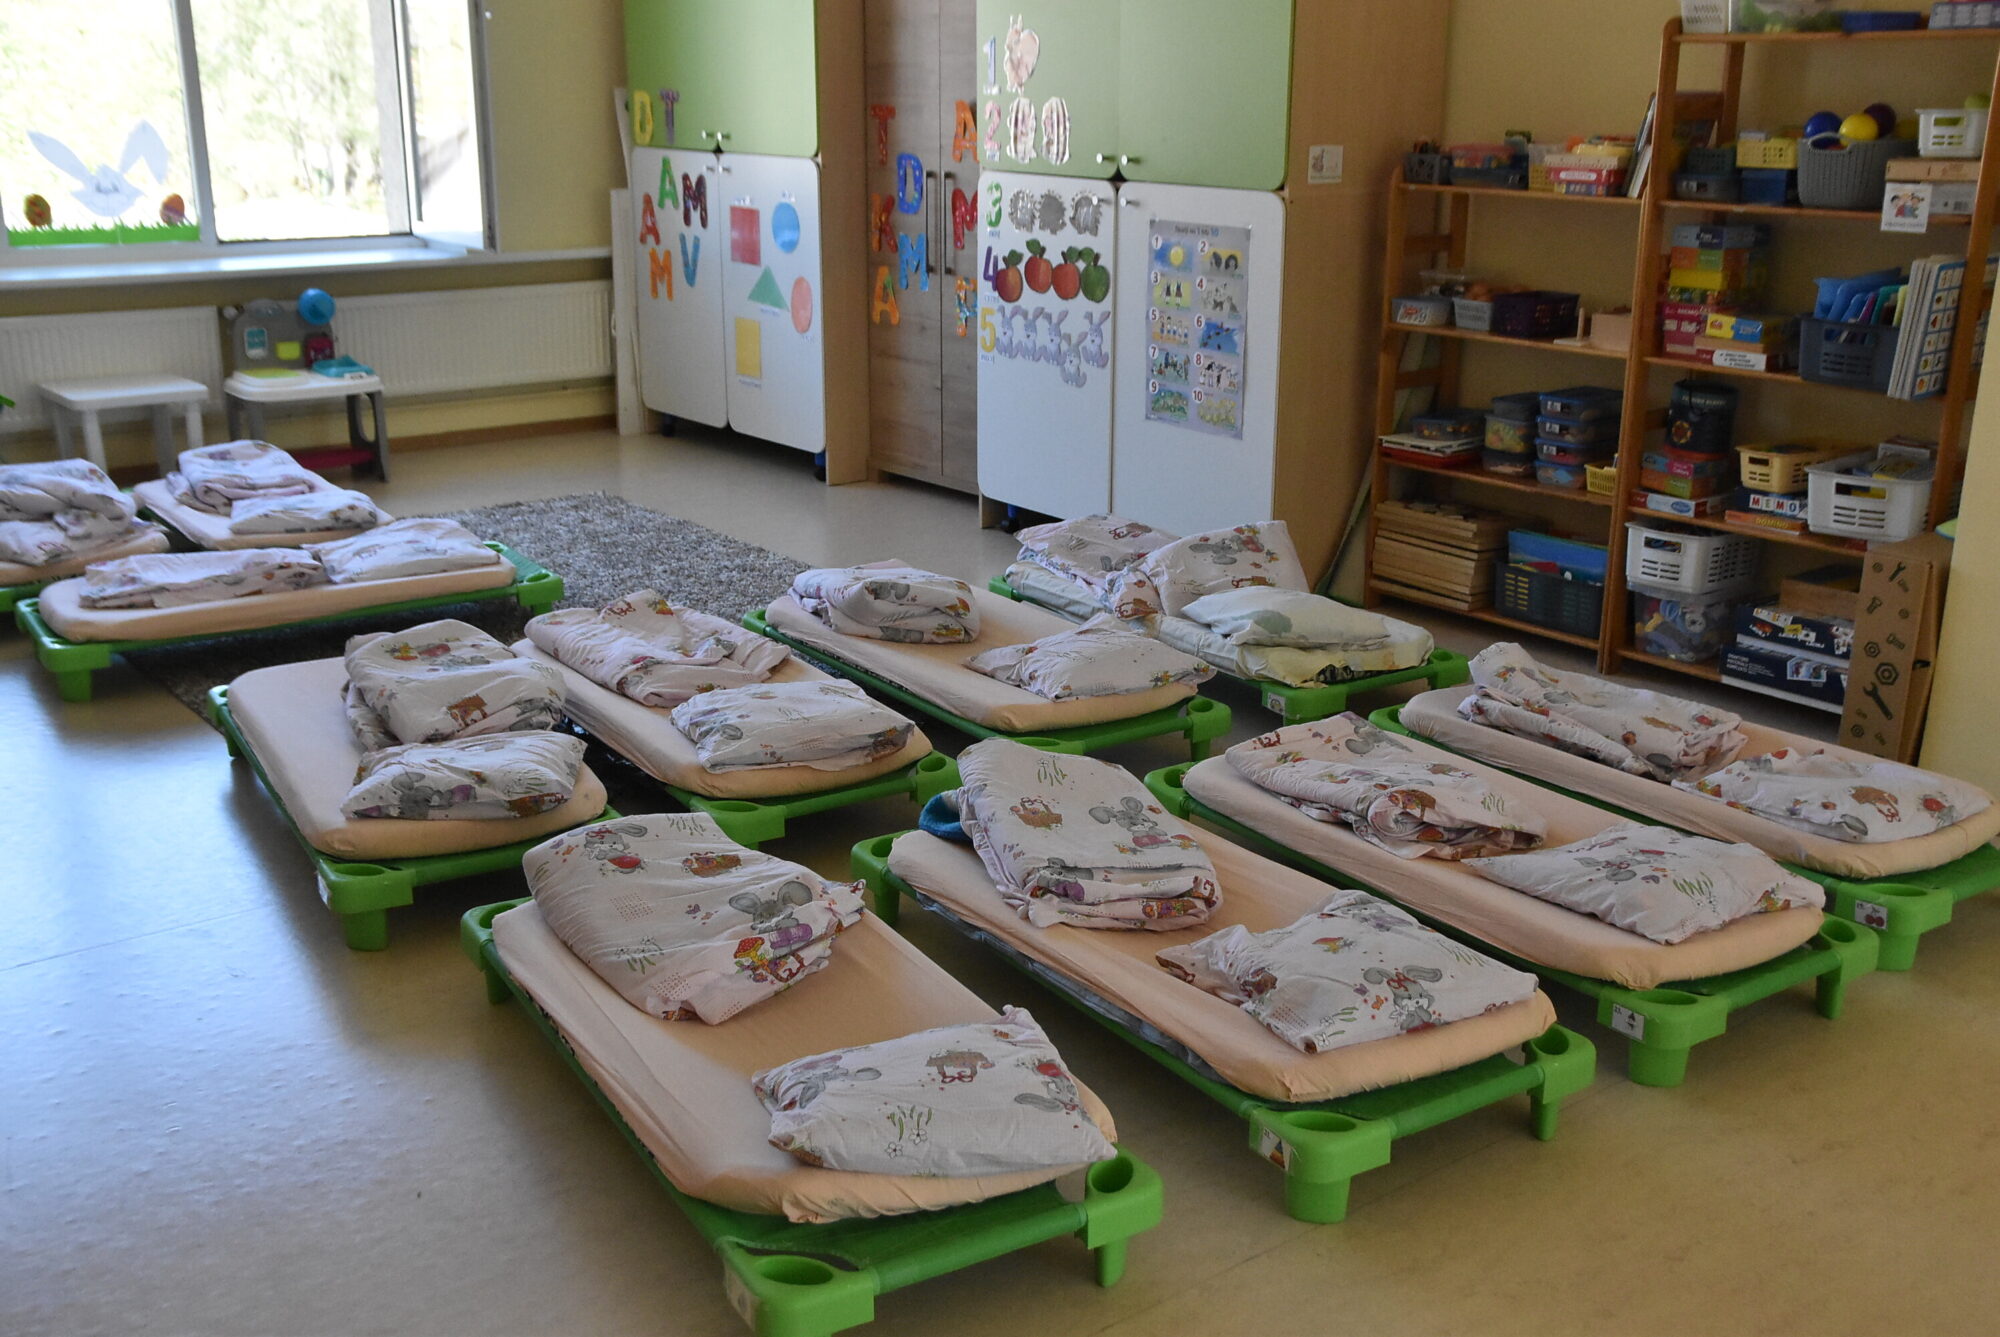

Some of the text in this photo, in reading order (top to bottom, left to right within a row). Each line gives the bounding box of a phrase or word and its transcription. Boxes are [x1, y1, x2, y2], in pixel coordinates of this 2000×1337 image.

[659, 88, 680, 144] T
[870, 103, 896, 166] T
[952, 99, 979, 163] A
[983, 100, 1002, 150] 2
[658, 155, 679, 210] A
[682, 172, 708, 229] M
[896, 152, 924, 215] D
[986, 181, 1003, 228] 3
[639, 193, 661, 246] A
[871, 192, 898, 254] K
[679, 232, 700, 288] V
[898, 233, 930, 292] M
[983, 246, 999, 292] 4
[1200, 241, 1207, 253] 2
[649, 248, 674, 301] M
[872, 265, 900, 326] A
[1153, 272, 1159, 284] 3
[1197, 277, 1204, 289] 4
[980, 307, 998, 353] 5
[1151, 309, 1157, 320] 5
[1196, 316, 1202, 327] 6
[1195, 355, 1201, 366] 8
[1151, 381, 1157, 393] 9
[1193, 390, 1203, 402] 10
[1751, 495, 1797, 513] MEMO
